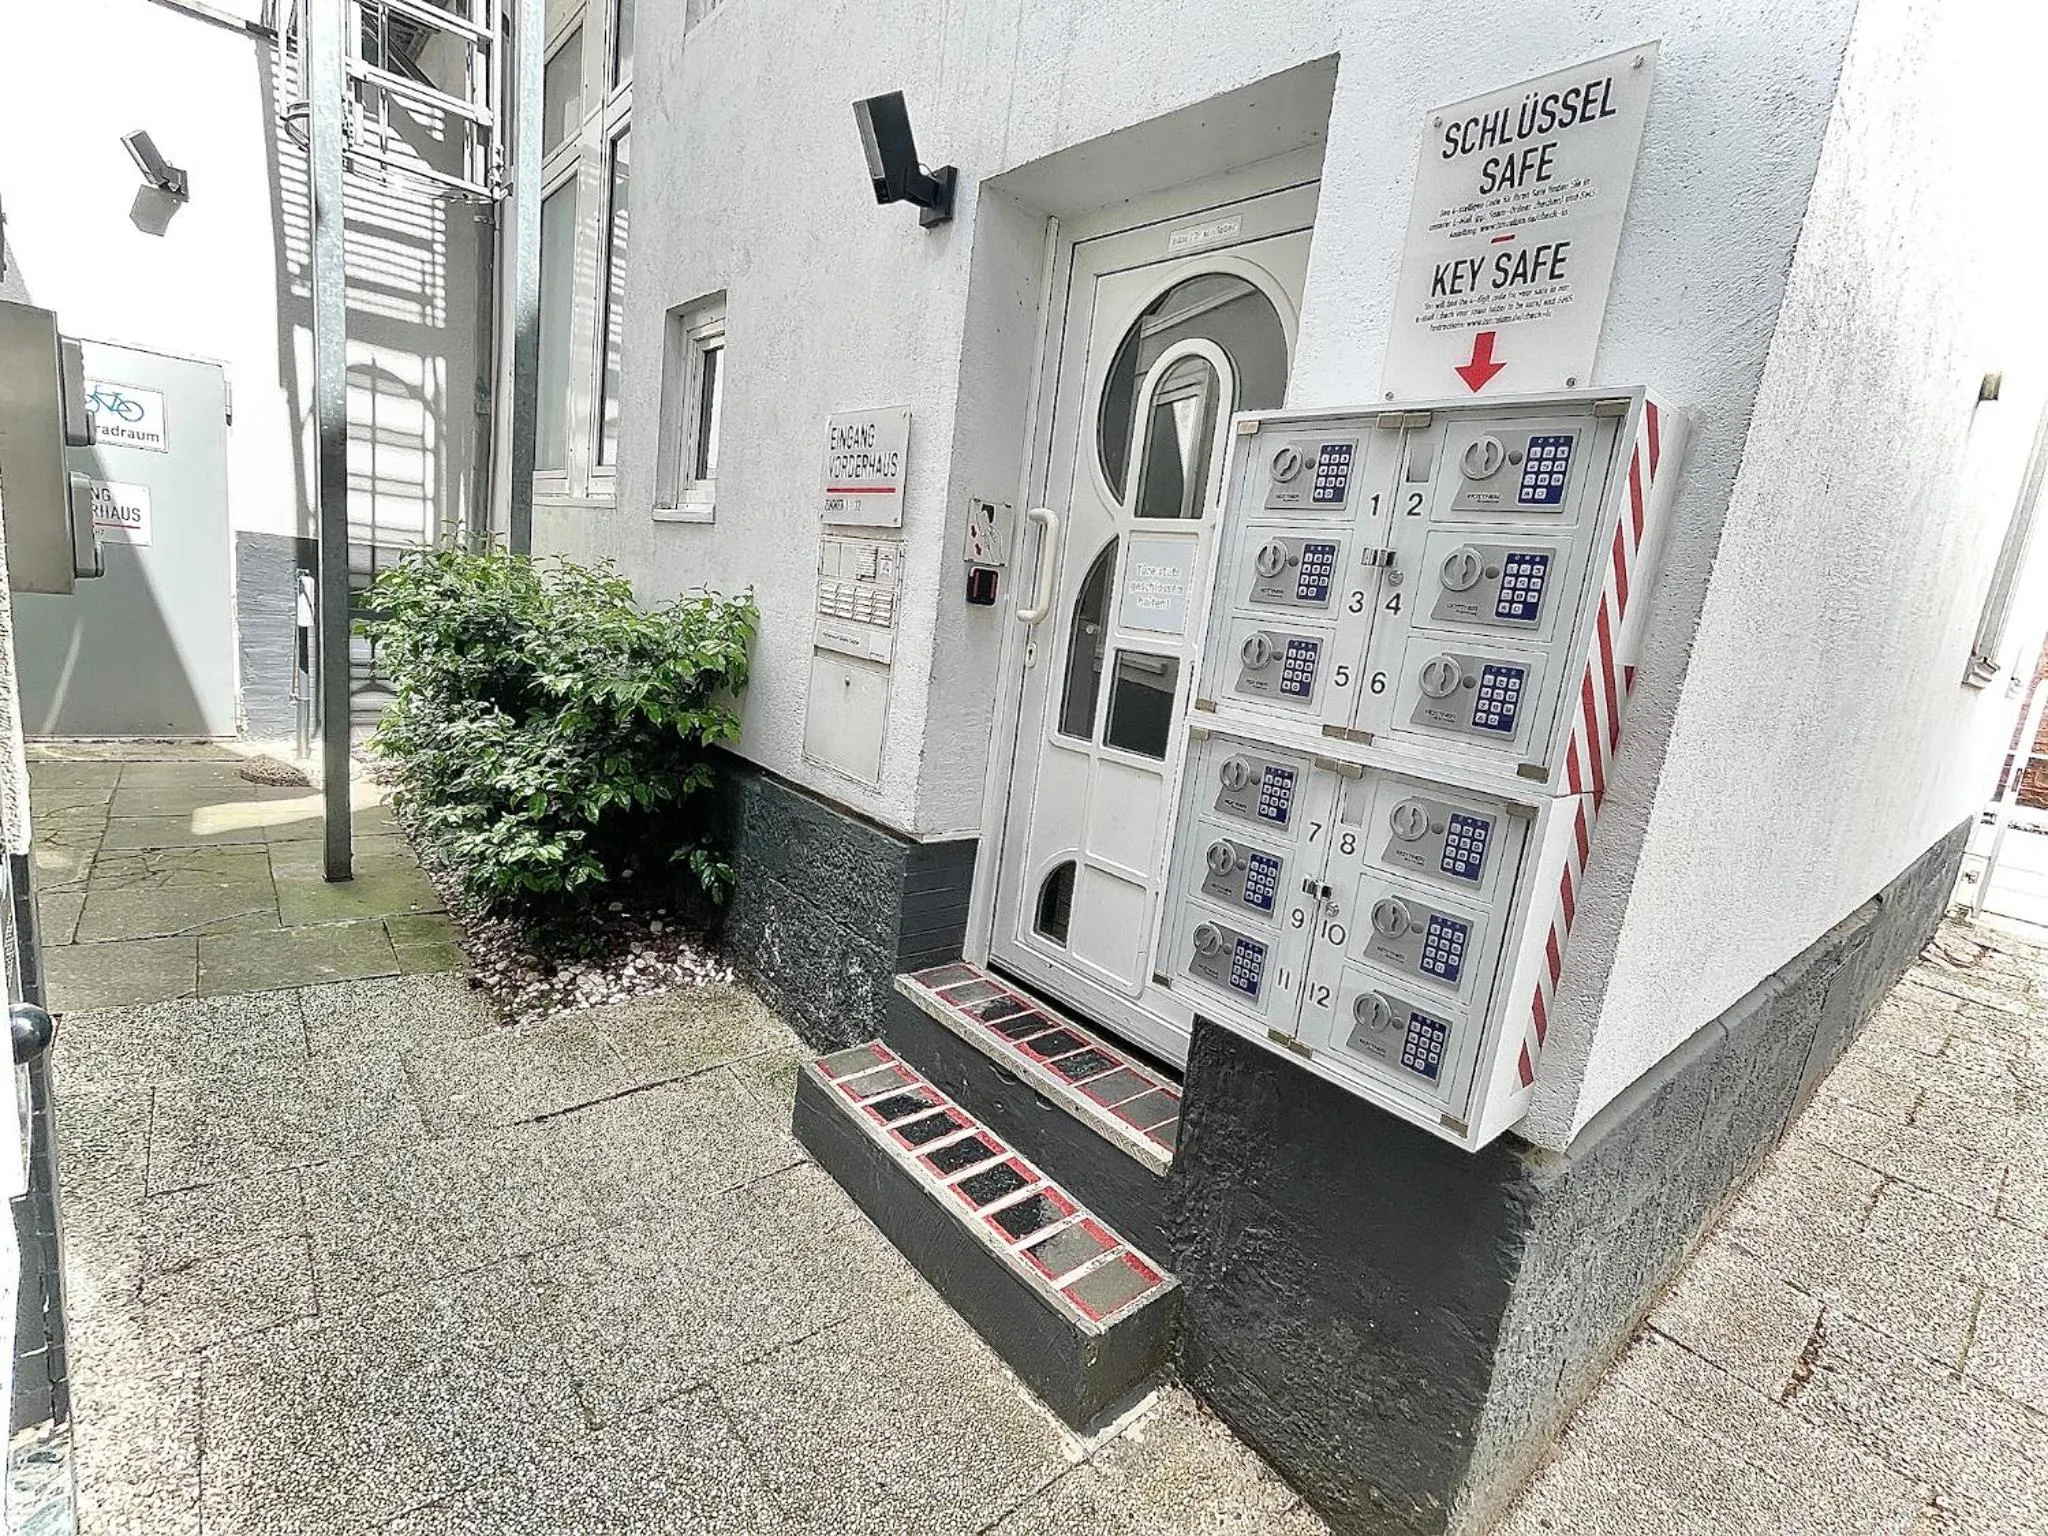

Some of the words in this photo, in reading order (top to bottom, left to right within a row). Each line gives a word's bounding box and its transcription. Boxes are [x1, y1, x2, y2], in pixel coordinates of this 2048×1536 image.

[1442, 77, 1617, 160] SCHLÜSSEL
[1480, 142, 1558, 195] SAFE
[1431, 256, 1485, 298] KEY
[1491, 242, 1571, 290] SAFE
[96, 424, 160, 443] radraum
[830, 423, 875, 450] EINGANG
[828, 452, 898, 479] VORDERHAUS
[1370, 493, 1381, 516] 1
[1406, 493, 1423, 516] 2
[1349, 591, 1365, 613] 3
[1385, 592, 1401, 615] 4
[1334, 666, 1350, 687] 5
[1370, 672, 1386, 694] 6
[1309, 822, 1322, 842] 7
[1340, 833, 1356, 855] 8
[1291, 909, 1304, 928] 9
[1321, 920, 1346, 945] 10
[1278, 968, 1290, 990] 11
[1309, 982, 1331, 1008] 12
